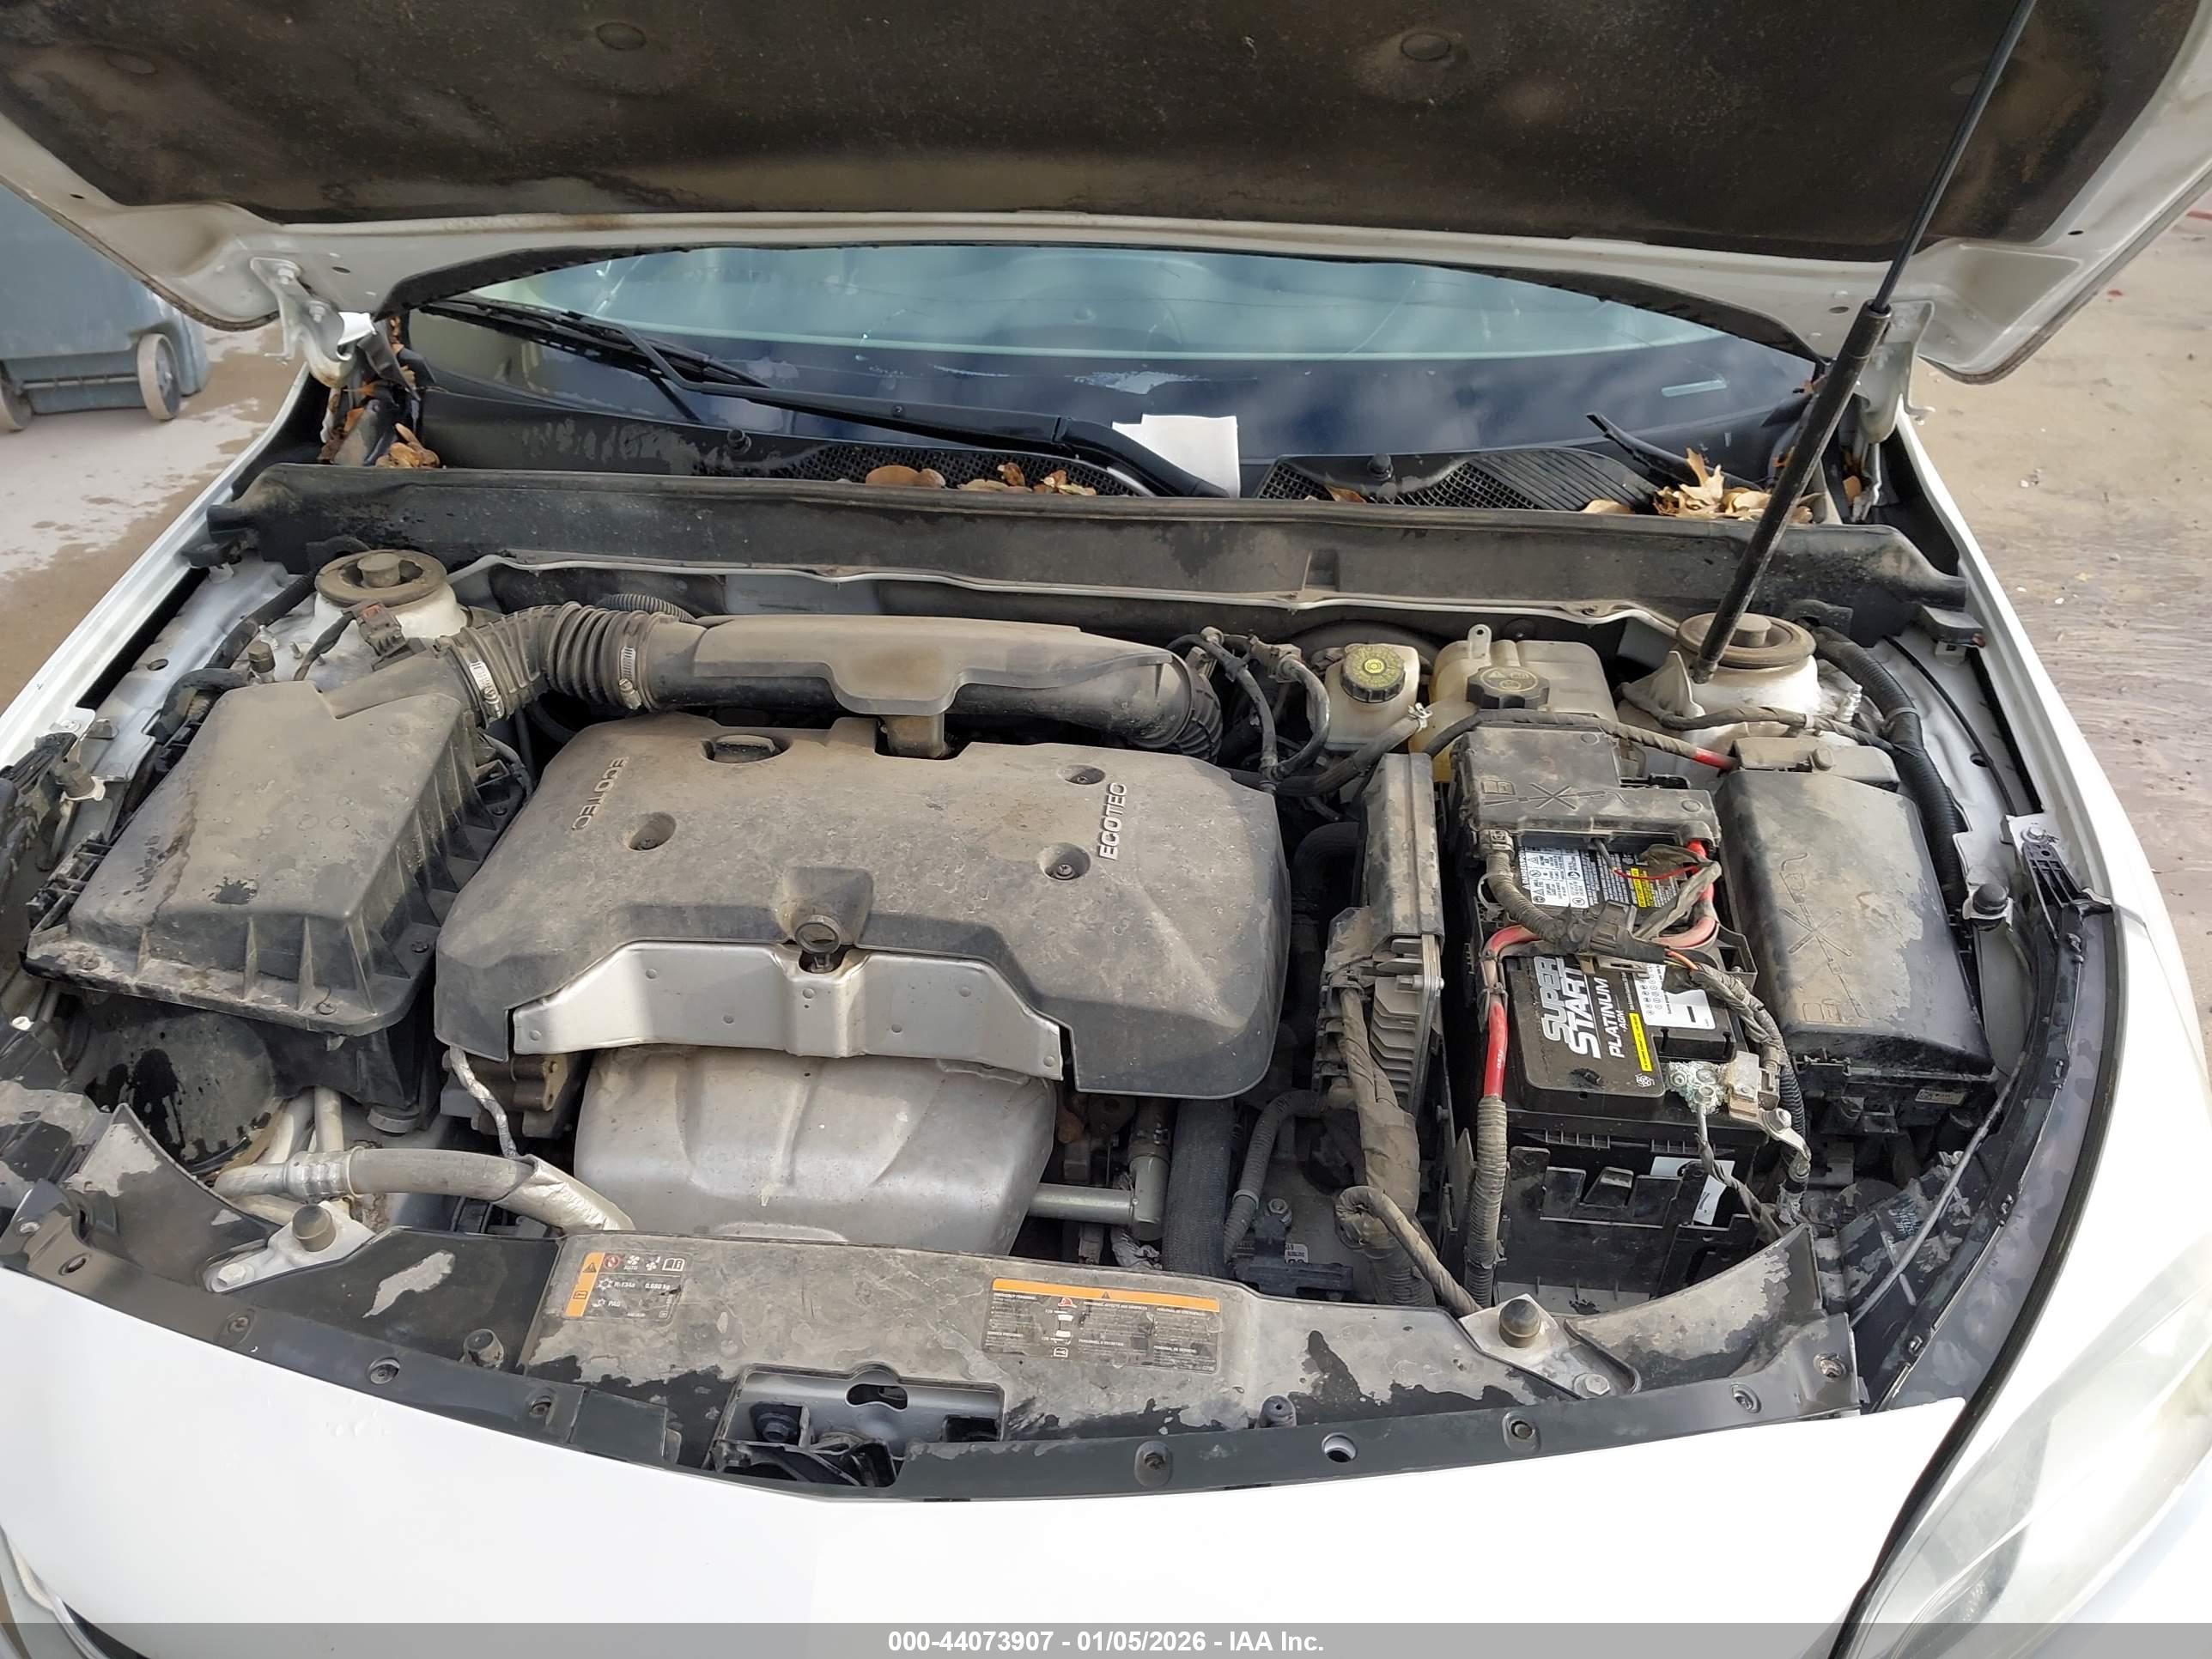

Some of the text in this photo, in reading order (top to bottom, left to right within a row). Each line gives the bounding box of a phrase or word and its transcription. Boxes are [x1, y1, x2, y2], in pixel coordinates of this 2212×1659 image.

[571, 757, 629, 830] ECOTEC
[1098, 782, 1127, 860] ECOTEC
[1534, 957, 1571, 1044] SUPER
[1556, 957, 1601, 1060] START
[1594, 977, 1626, 1058] PLATINUM
